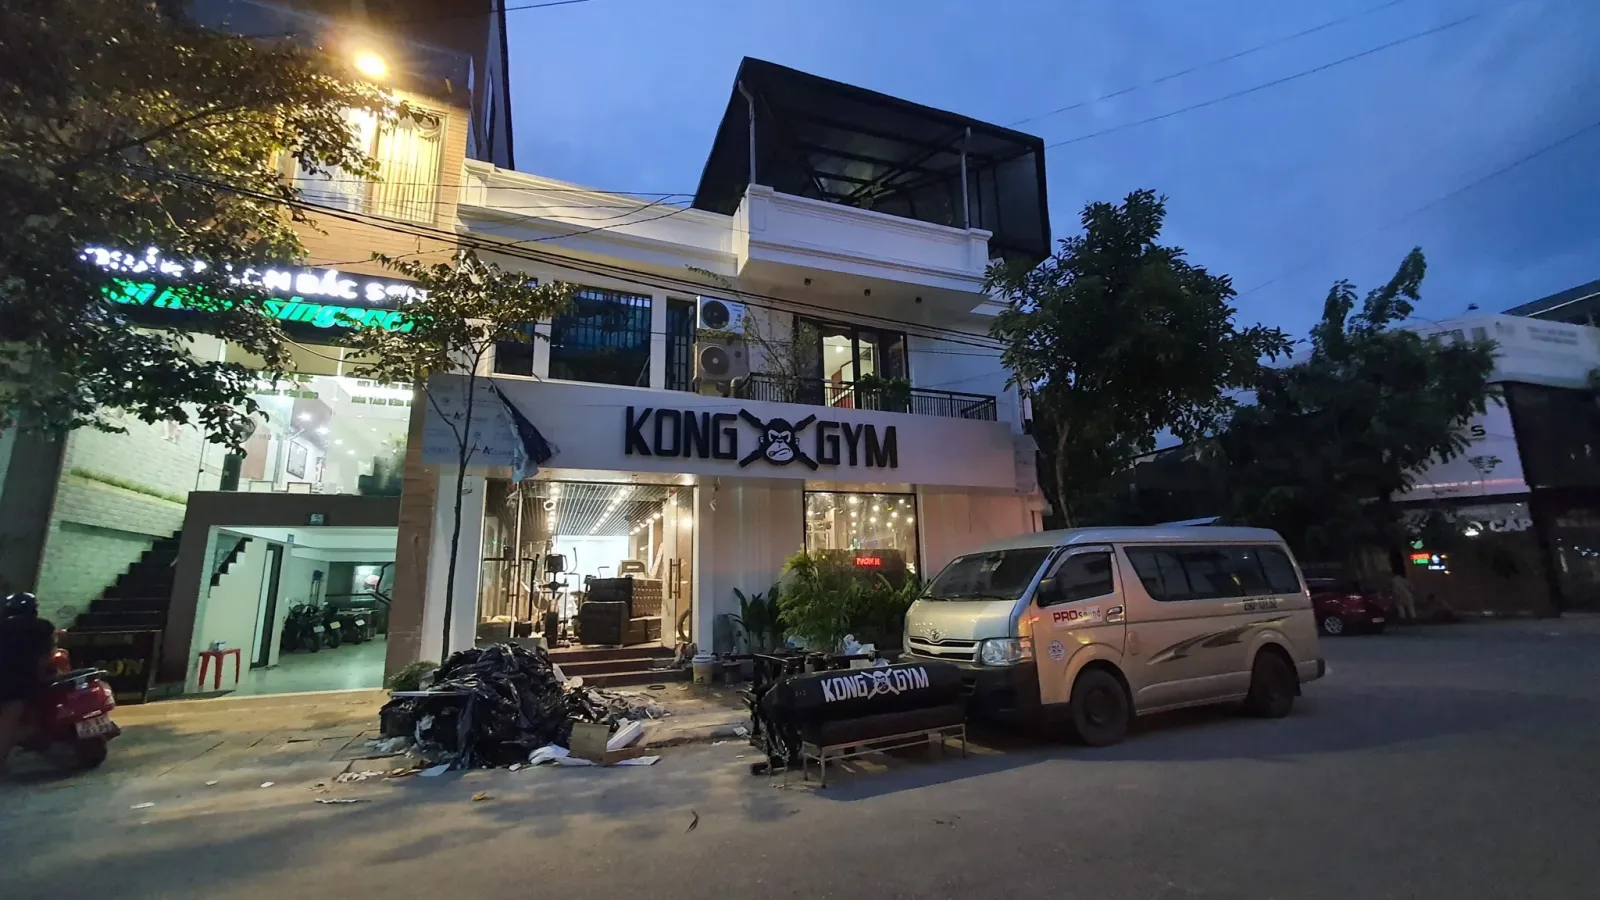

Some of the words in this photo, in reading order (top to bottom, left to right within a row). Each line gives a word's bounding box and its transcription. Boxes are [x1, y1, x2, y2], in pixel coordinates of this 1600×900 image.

[625, 406, 738, 460] KONG
[816, 420, 898, 468] GYM
[820, 674, 868, 703] KONG
[893, 666, 929, 692] GYM
